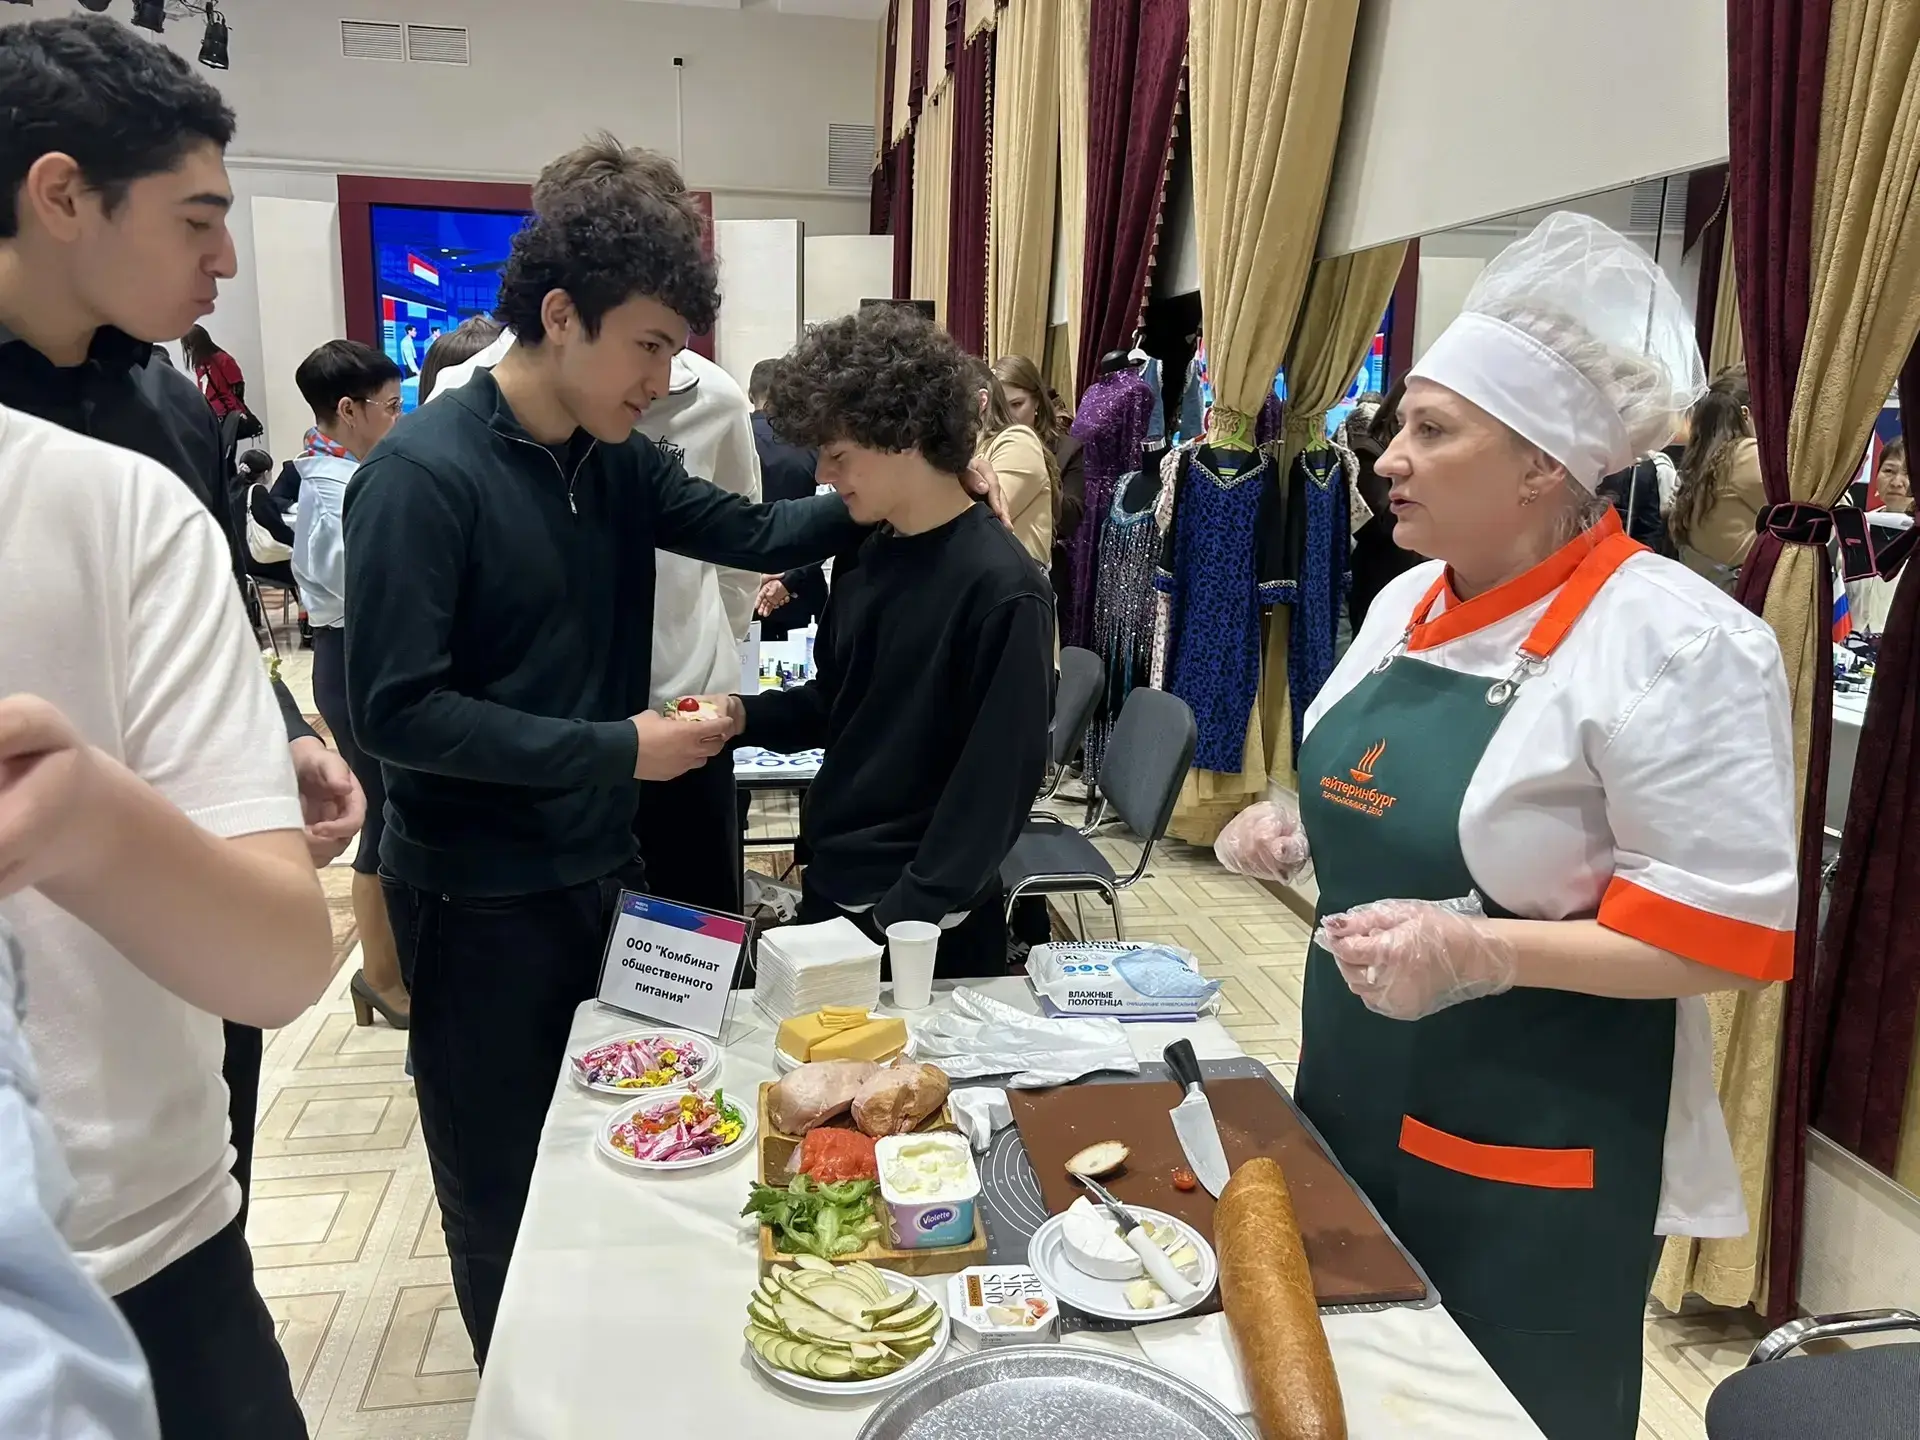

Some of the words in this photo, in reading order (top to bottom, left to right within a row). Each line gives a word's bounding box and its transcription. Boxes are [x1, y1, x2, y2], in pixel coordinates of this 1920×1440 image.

[1320, 776, 1397, 808] кейтеринбург
[626, 937, 652, 953] ООО
[655, 944, 720, 973] "Комбинат
[621, 957, 713, 992] общественного
[635, 981, 690, 1004] питания"
[1067, 998, 1123, 1007] ПОЛОТЕНЦА
[1068, 991, 1113, 999] ВЛАЖНЫЕ
[922, 1211, 951, 1225] Violette
